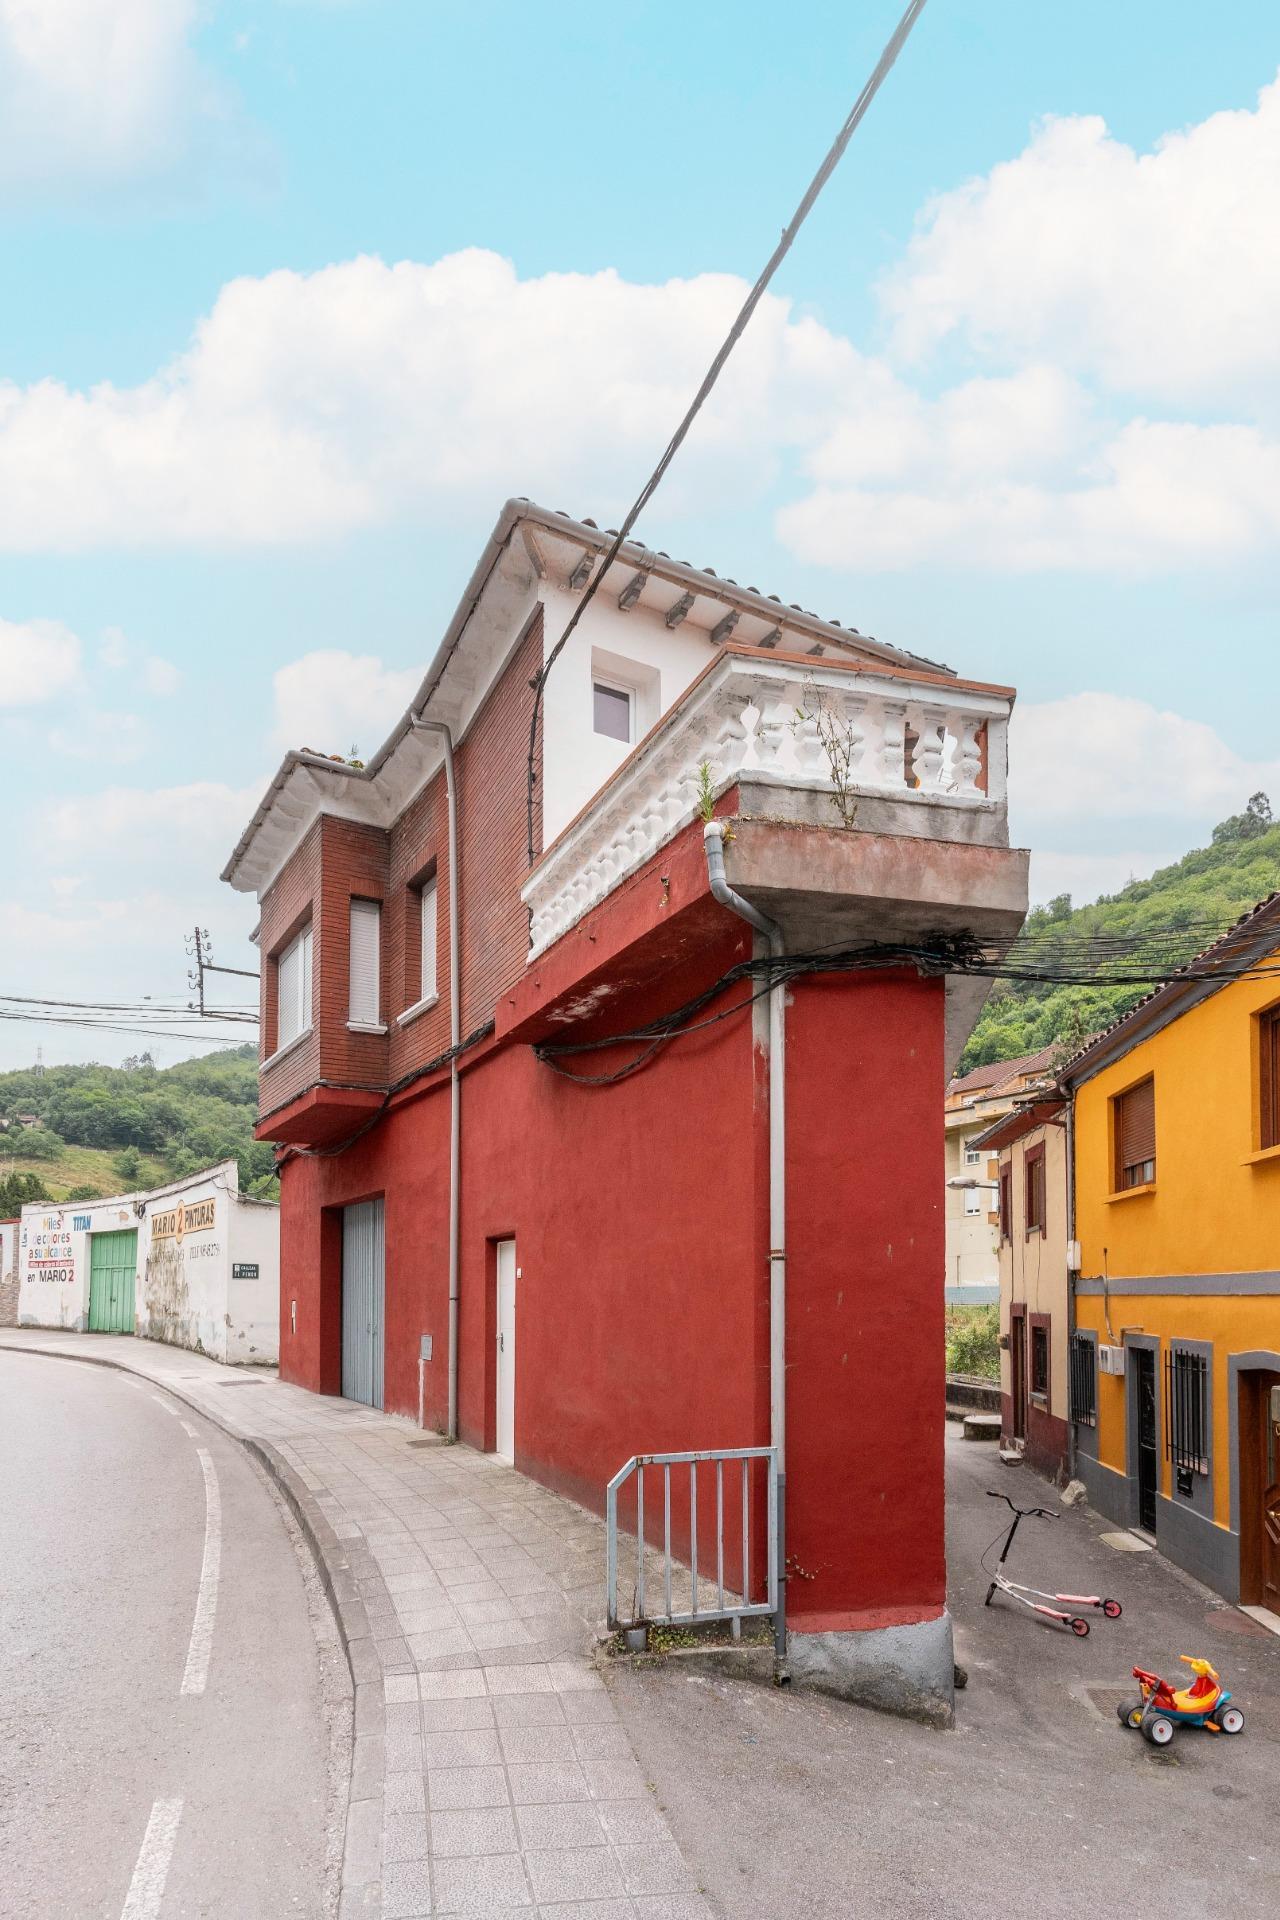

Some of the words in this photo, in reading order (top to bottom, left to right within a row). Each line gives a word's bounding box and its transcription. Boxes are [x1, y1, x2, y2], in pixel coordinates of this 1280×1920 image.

[73, 1215, 91, 1231] TITAN
[152, 1214, 176, 1236] MARIO
[177, 1208, 183, 1233] 2
[184, 1204, 215, 1229] PINTURAS
[28, 1274, 36, 1282] en
[40, 1269, 67, 1282] MARIO
[68, 1269, 75, 1282] 2
